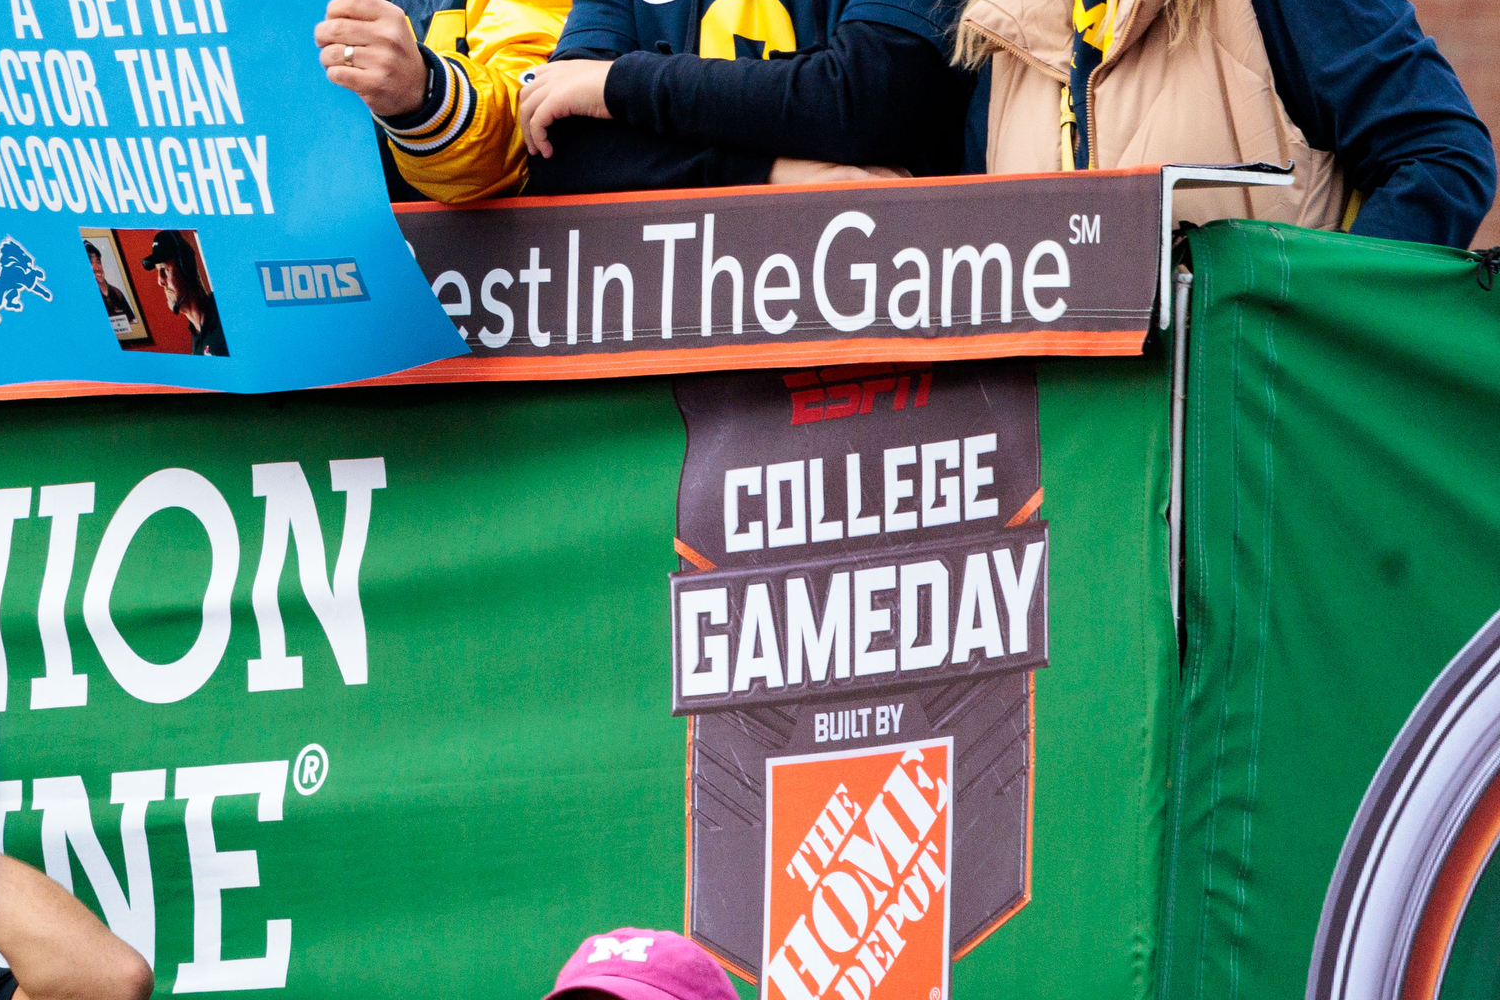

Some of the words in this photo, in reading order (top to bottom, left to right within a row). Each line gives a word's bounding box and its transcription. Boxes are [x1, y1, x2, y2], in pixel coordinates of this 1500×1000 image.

[116, 47, 244, 127] THAN
[261, 263, 363, 300] LIONS
[427, 211, 1071, 348] estInTheGame
[783, 363, 933, 426] ESPN
[724, 433, 999, 553] COLLEGE
[680, 541, 1045, 697] GAMEDAY
[815, 707, 871, 743] BUILT
[875, 703, 904, 736] BY
[767, 749, 947, 1000] HOME
[786, 783, 862, 891] THE
[587, 937, 655, 964] M
[835, 840, 945, 1000] DEPOT
